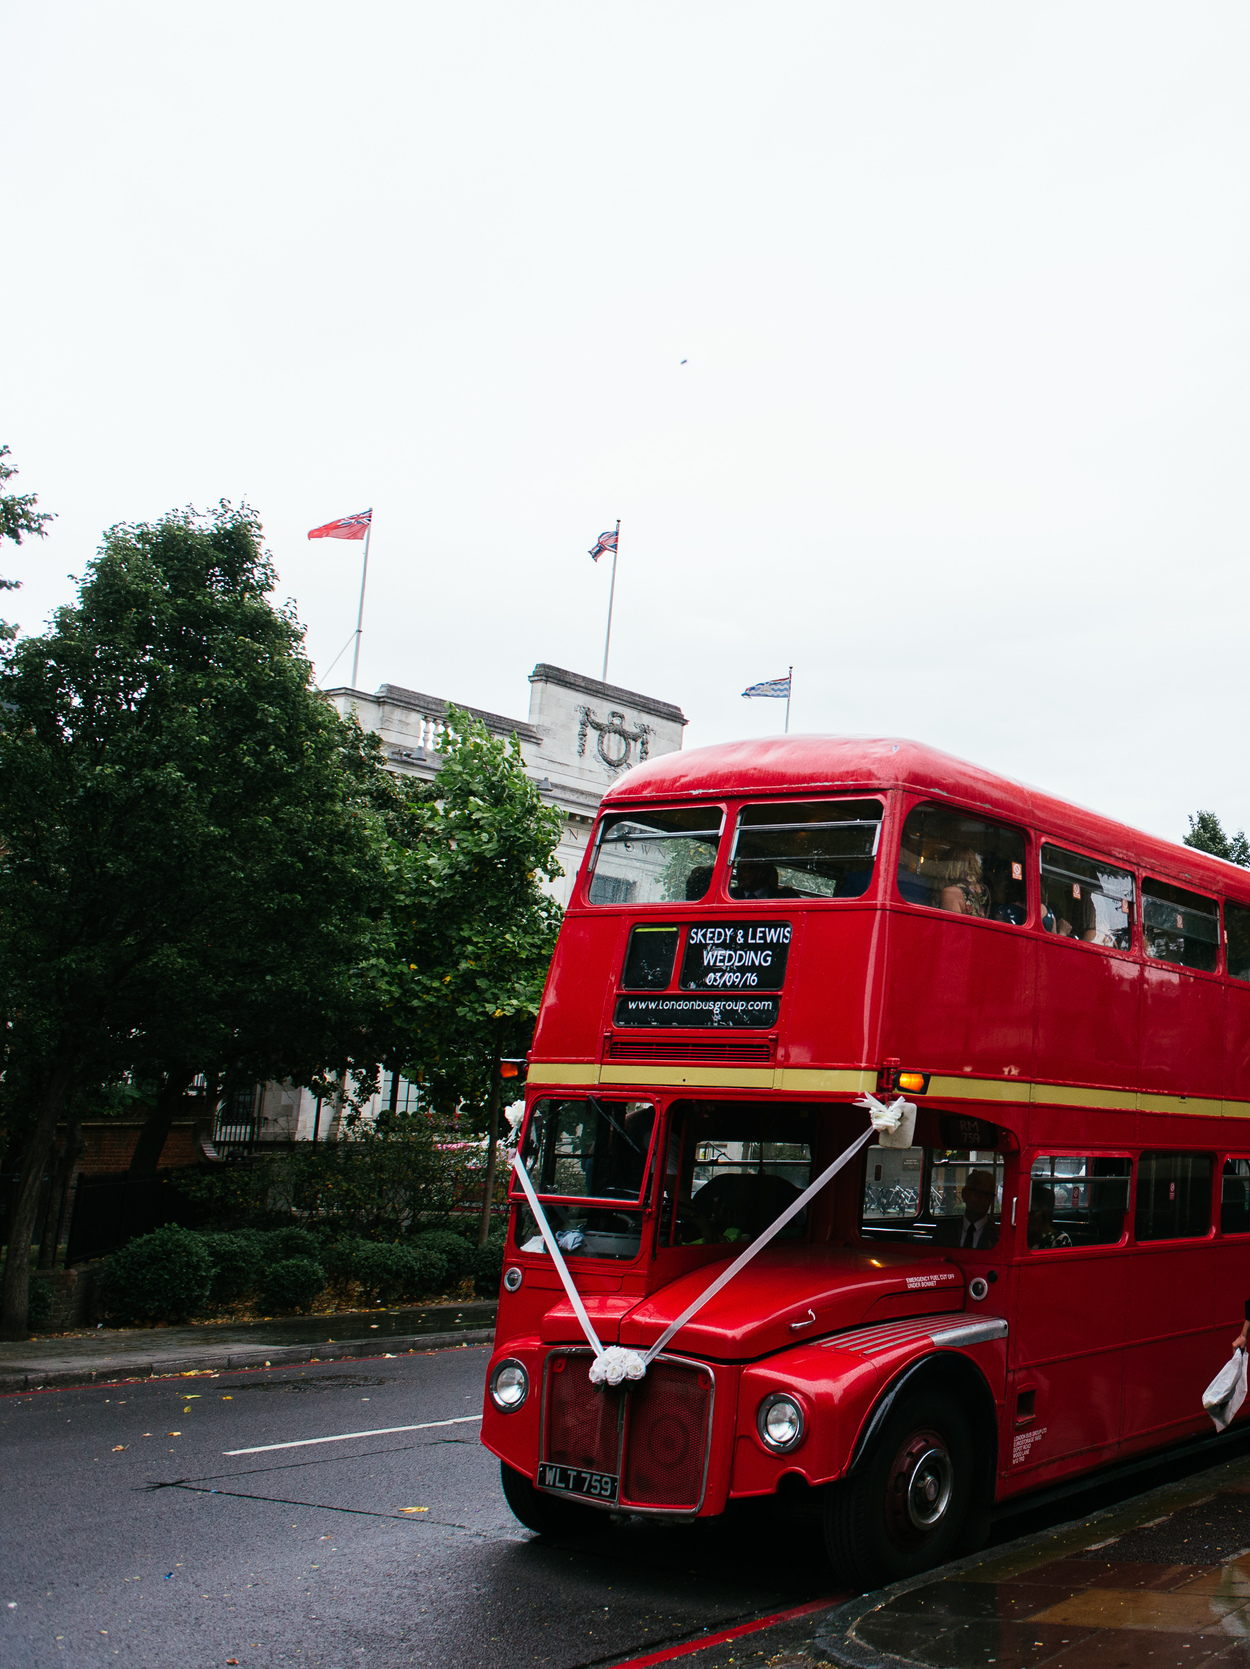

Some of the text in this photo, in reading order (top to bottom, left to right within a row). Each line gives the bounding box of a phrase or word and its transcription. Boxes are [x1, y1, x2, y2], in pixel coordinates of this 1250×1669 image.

[689, 927, 791, 945] SKEDY & LEWIS
[703, 950, 772, 967] WEDDING
[706, 972, 758, 988] 03/09/16
[628, 1000, 772, 1014] www.londonbusgroup.com
[960, 1121, 979, 1132] RM
[962, 1132, 981, 1144] 759
[545, 1466, 612, 1496] WLT 759
